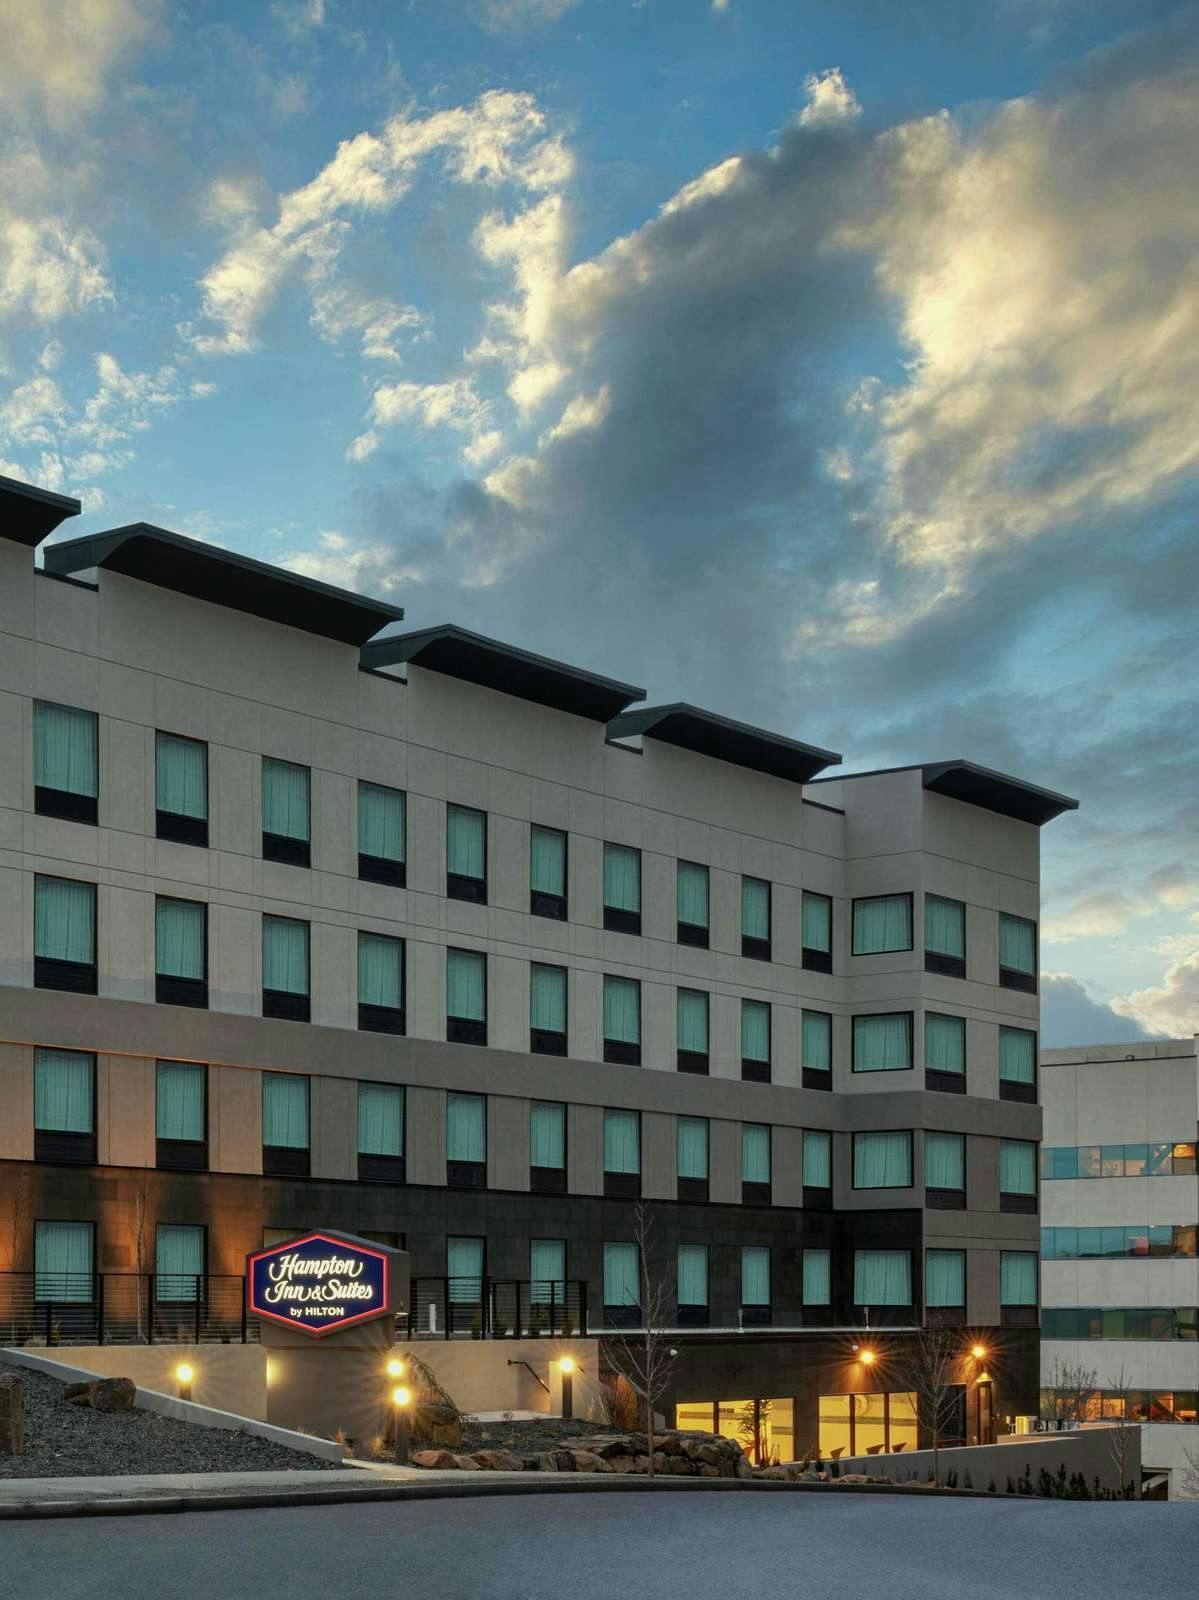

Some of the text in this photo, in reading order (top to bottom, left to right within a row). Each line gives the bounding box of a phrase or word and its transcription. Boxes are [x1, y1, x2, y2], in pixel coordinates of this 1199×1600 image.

[269, 1253, 363, 1281] Hampton
[265, 1279, 373, 1303] Inn & Suites
[290, 1307, 344, 1318] by HILTON
